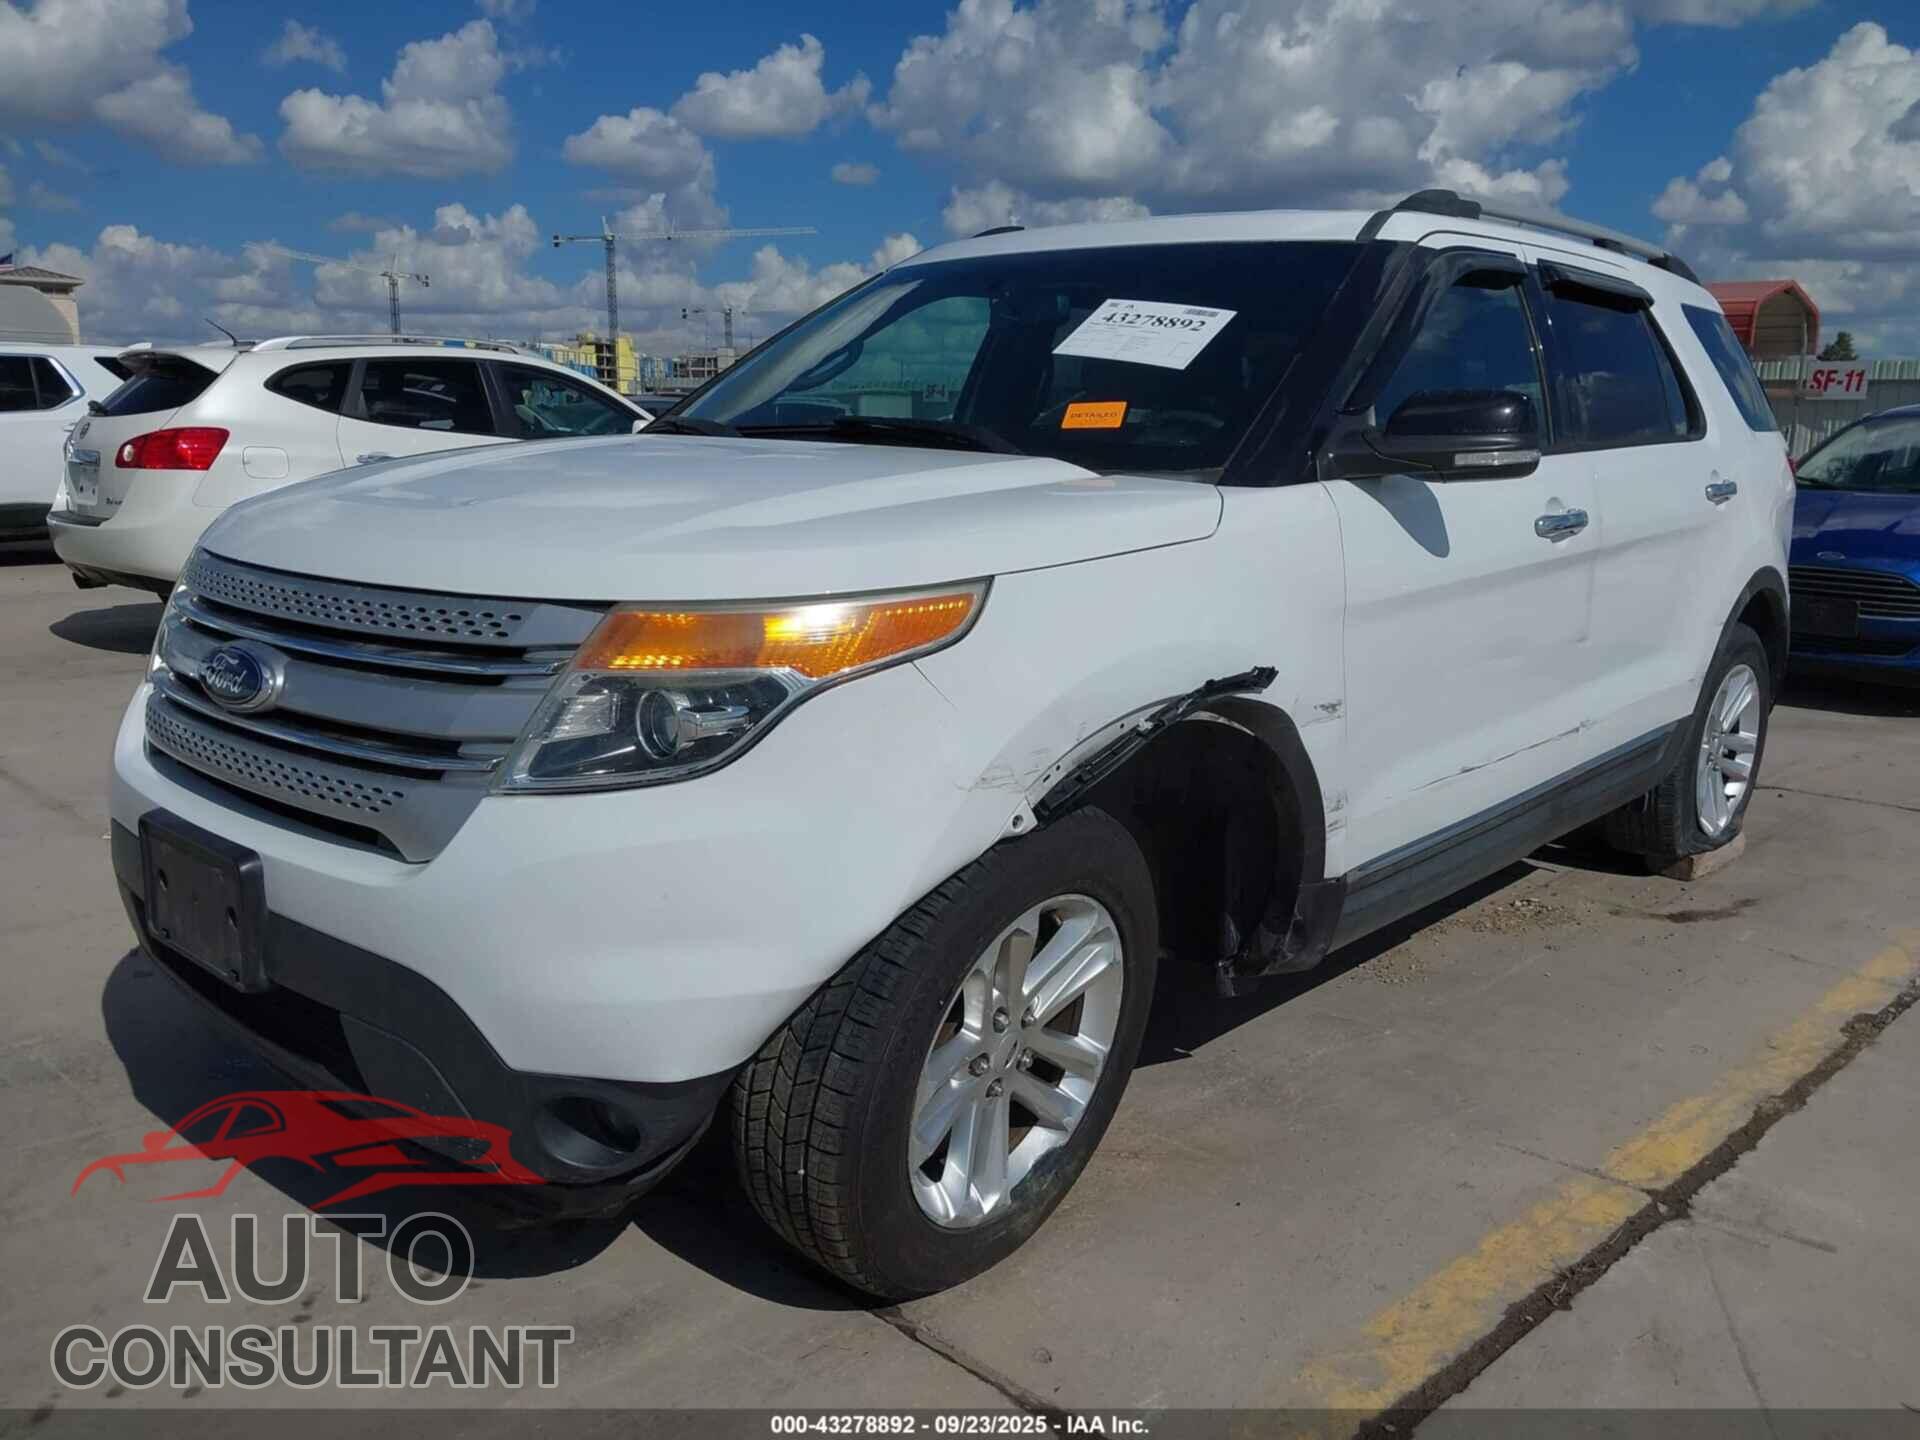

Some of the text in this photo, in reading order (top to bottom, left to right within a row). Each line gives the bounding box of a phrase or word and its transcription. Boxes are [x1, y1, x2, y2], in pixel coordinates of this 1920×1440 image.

[1102, 312, 1206, 332] 43278892
[1808, 368, 1867, 393] SF-11
[205, 652, 247, 694] Ford
